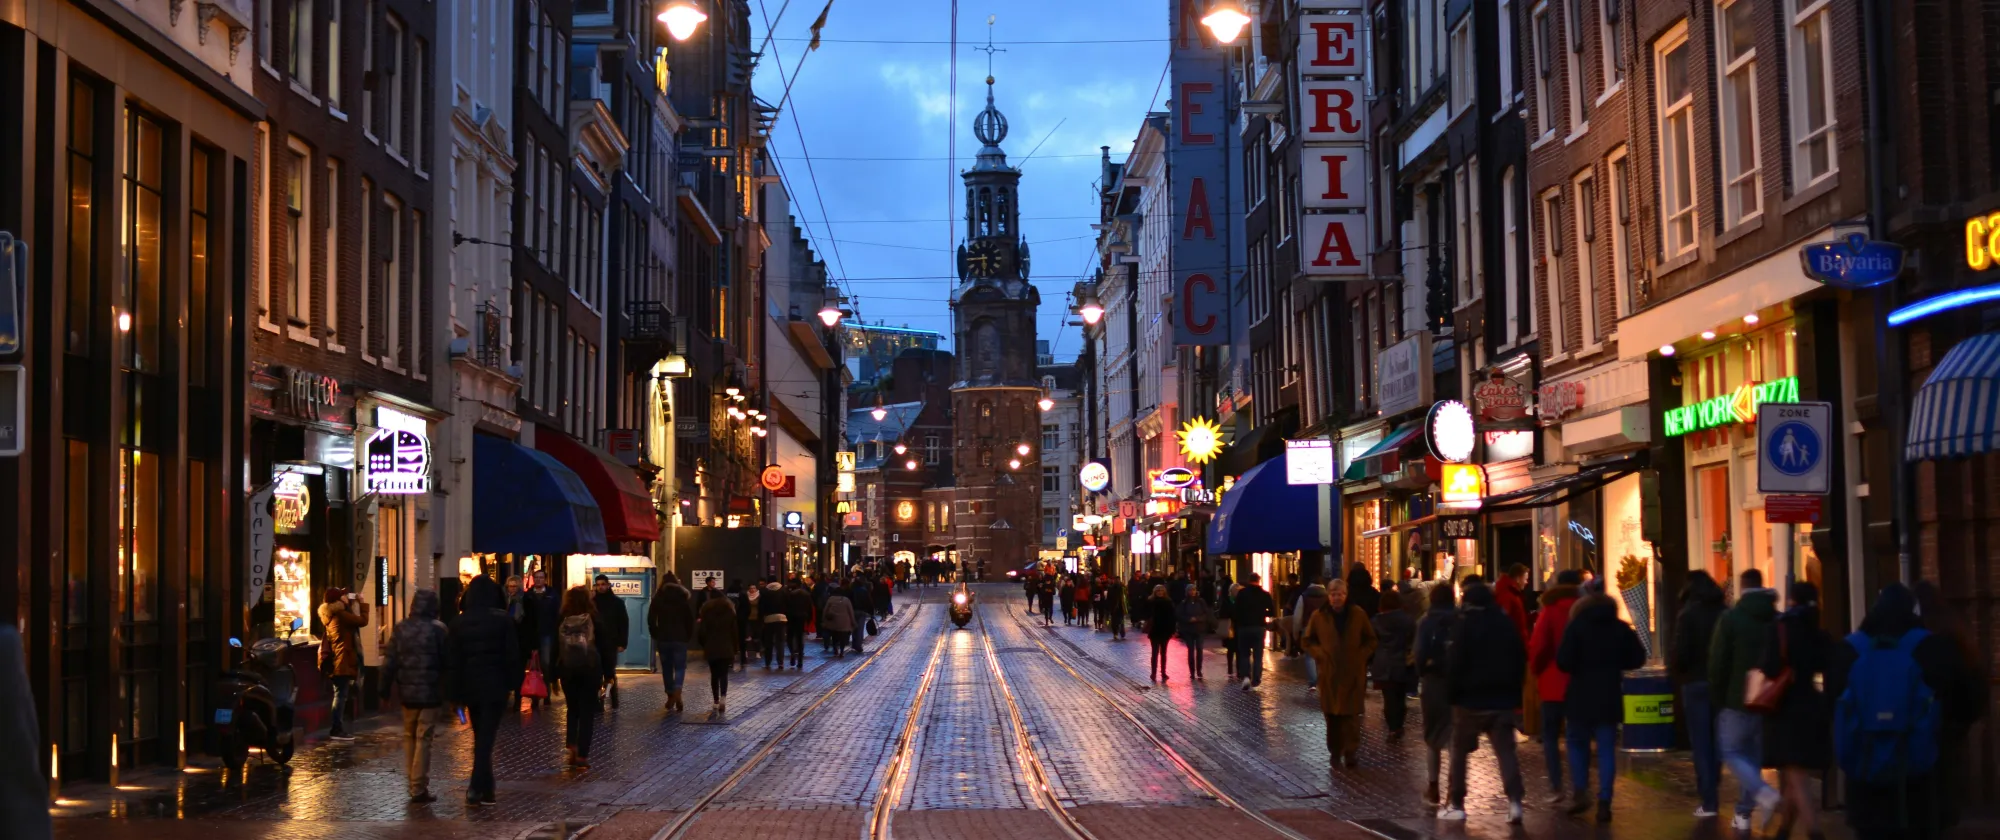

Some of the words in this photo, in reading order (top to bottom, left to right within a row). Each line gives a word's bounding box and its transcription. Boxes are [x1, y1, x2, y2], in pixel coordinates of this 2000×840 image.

[1819, 254, 1893, 272] Bavaria
[1664, 403, 1697, 437] NEW
[1697, 387, 1744, 429] YORK
[1752, 376, 1800, 414] PIZZA
[1779, 408, 1811, 418] ZONE
[1084, 473, 1106, 485] KING
[252, 502, 264, 587] TATTOO
